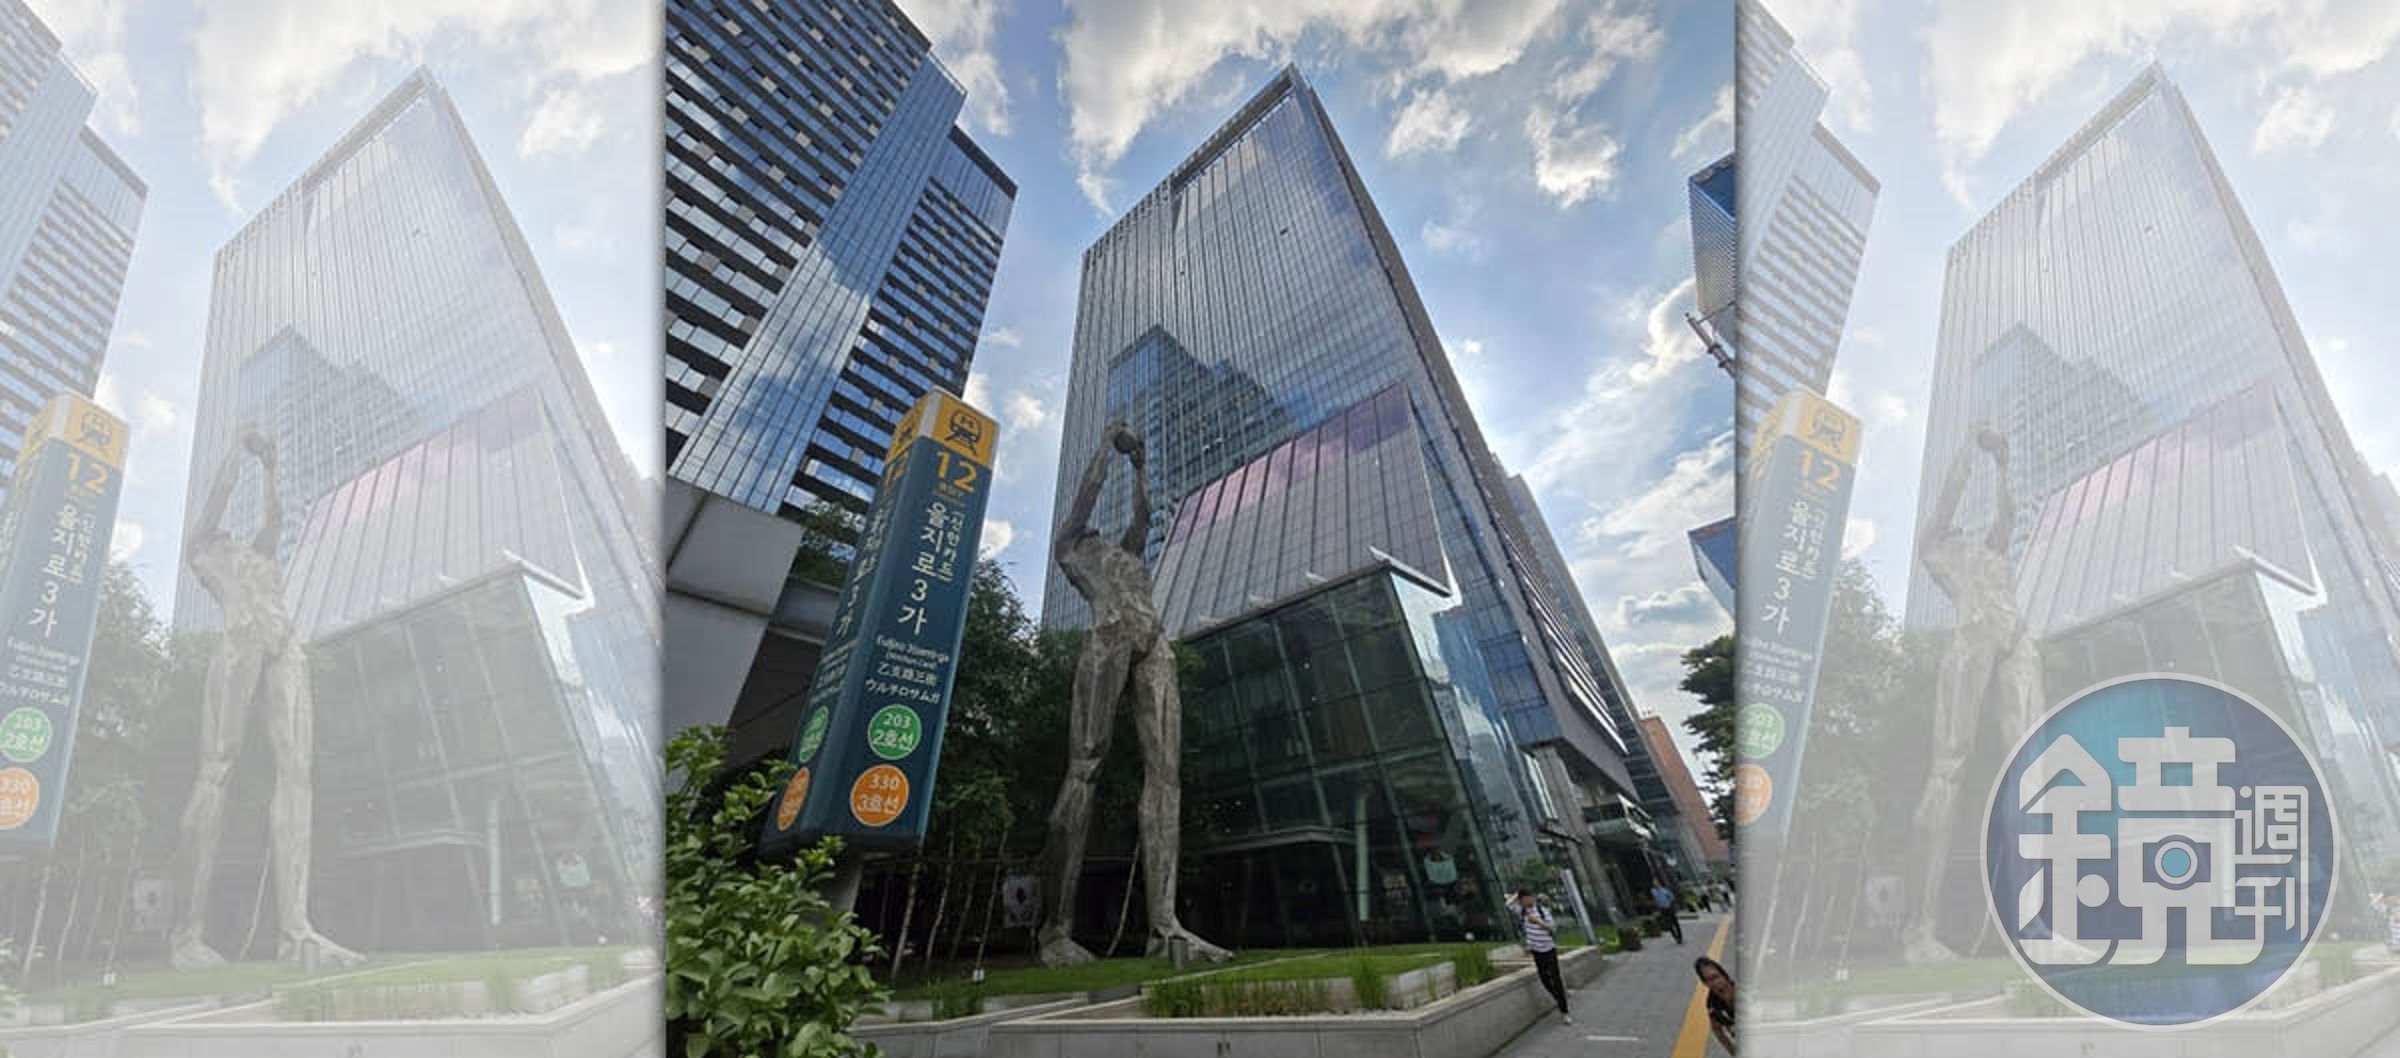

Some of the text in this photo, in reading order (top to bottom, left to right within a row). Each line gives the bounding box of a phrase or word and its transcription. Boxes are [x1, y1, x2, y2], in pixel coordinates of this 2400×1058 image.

[67, 451, 108, 493] 12
[936, 451, 977, 493] 12
[1800, 450, 1840, 491] 12
[883, 712, 912, 729] 203
[872, 729, 914, 750] 2호선
[868, 774, 900, 791] 330
